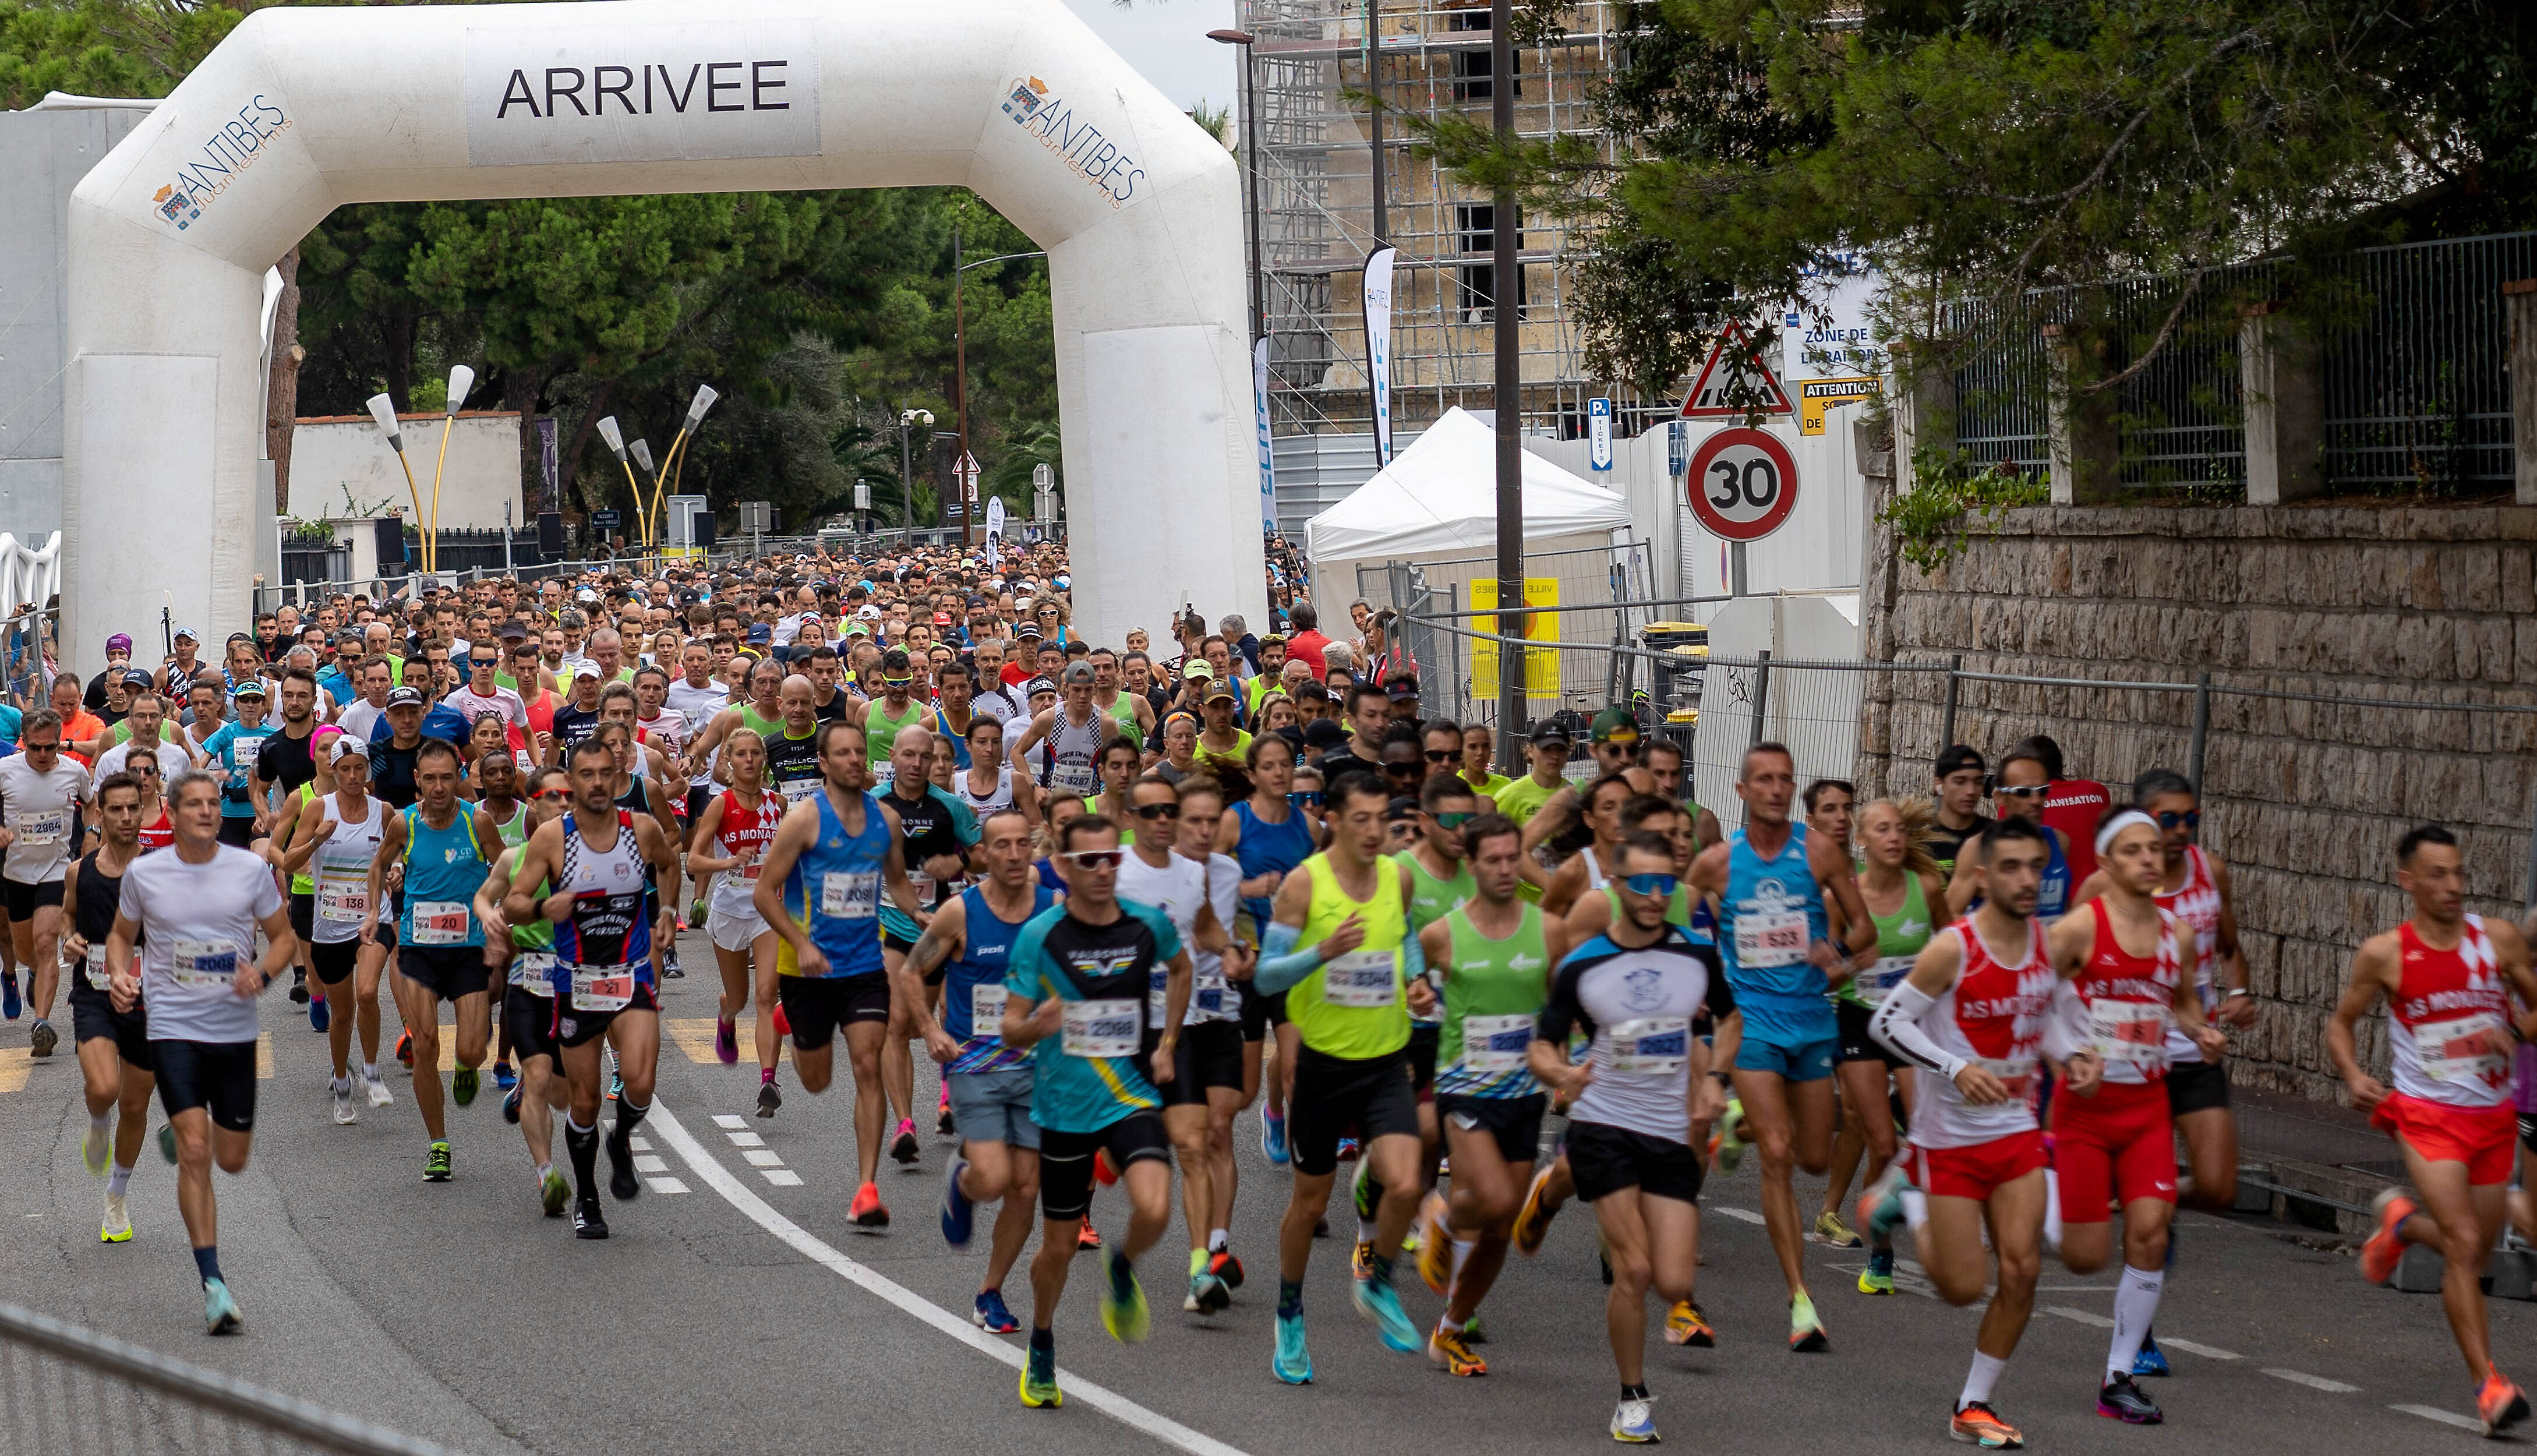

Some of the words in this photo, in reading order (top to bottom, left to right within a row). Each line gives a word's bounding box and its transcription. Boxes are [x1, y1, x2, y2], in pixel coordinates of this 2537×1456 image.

[496, 61, 789, 118] ARRIVEE
[178, 95, 284, 205] ANTIBES
[1028, 98, 1144, 200] ANTIBES
[1805, 330, 1845, 342] ZONE
[1850, 328, 1868, 340] DE
[1807, 381, 1877, 396] ATTENTION
[1806, 418, 1821, 429] DE
[1710, 458, 1777, 508] 30
[1068, 776, 1090, 786] 3287
[725, 831, 737, 844] AS
[345, 897, 364, 909] 138
[441, 917, 457, 928] 20
